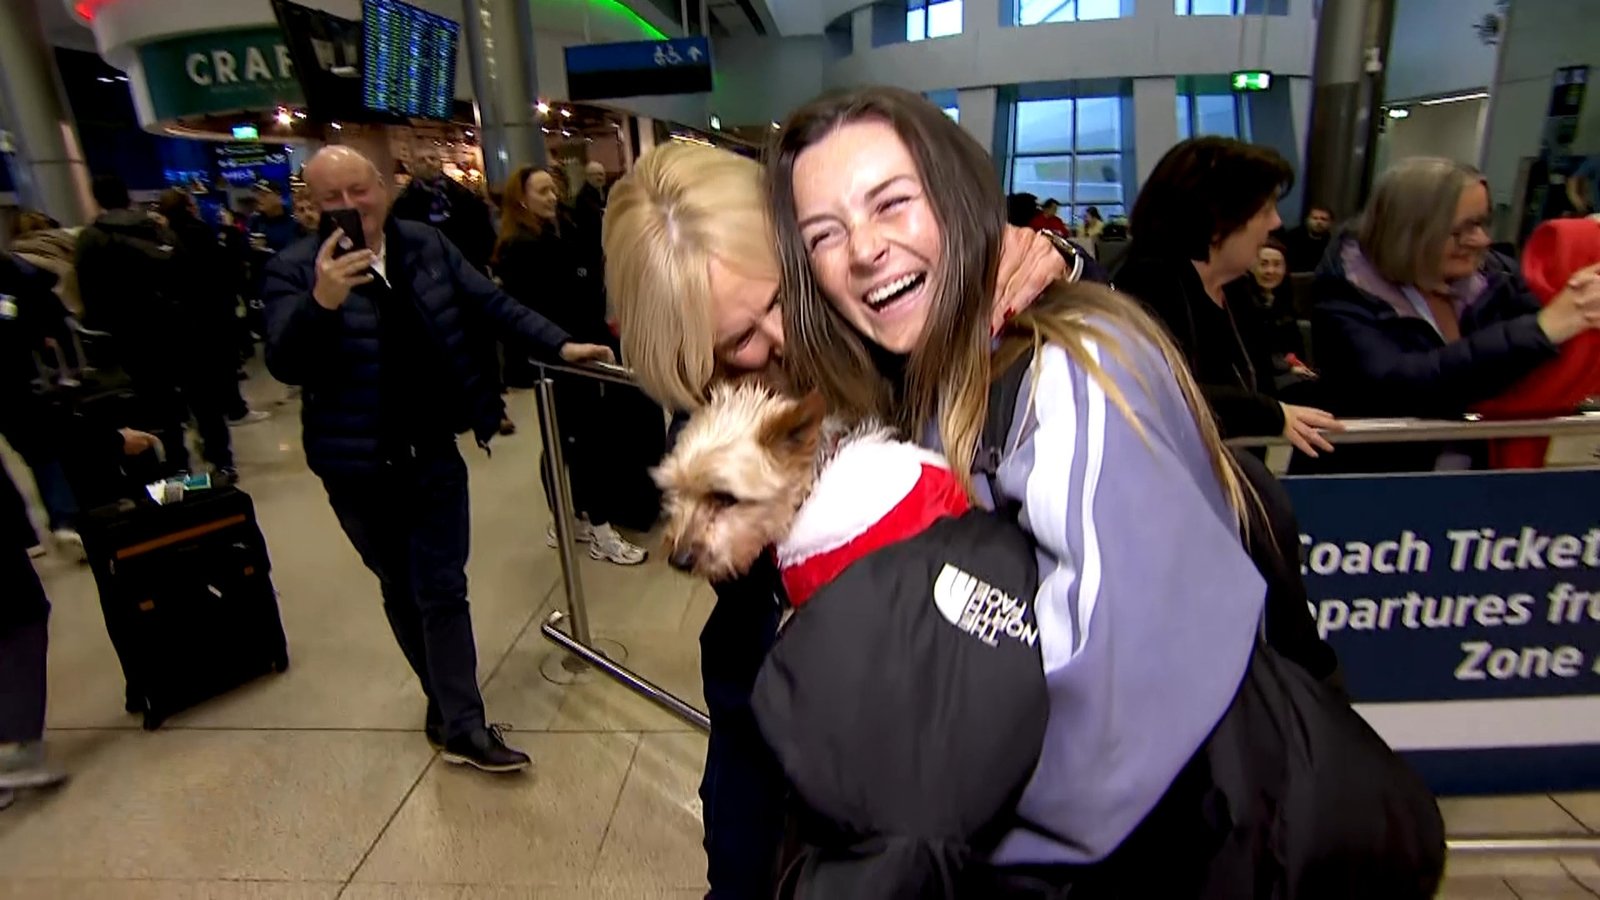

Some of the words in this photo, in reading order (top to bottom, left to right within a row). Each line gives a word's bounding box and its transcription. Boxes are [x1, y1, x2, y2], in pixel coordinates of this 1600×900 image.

[972, 580, 1027, 620] FACE
[1307, 590, 1535, 641] partures
[958, 611, 998, 646] THE
[964, 597, 1038, 647] NORTH
[1454, 641, 1584, 681] Zone
